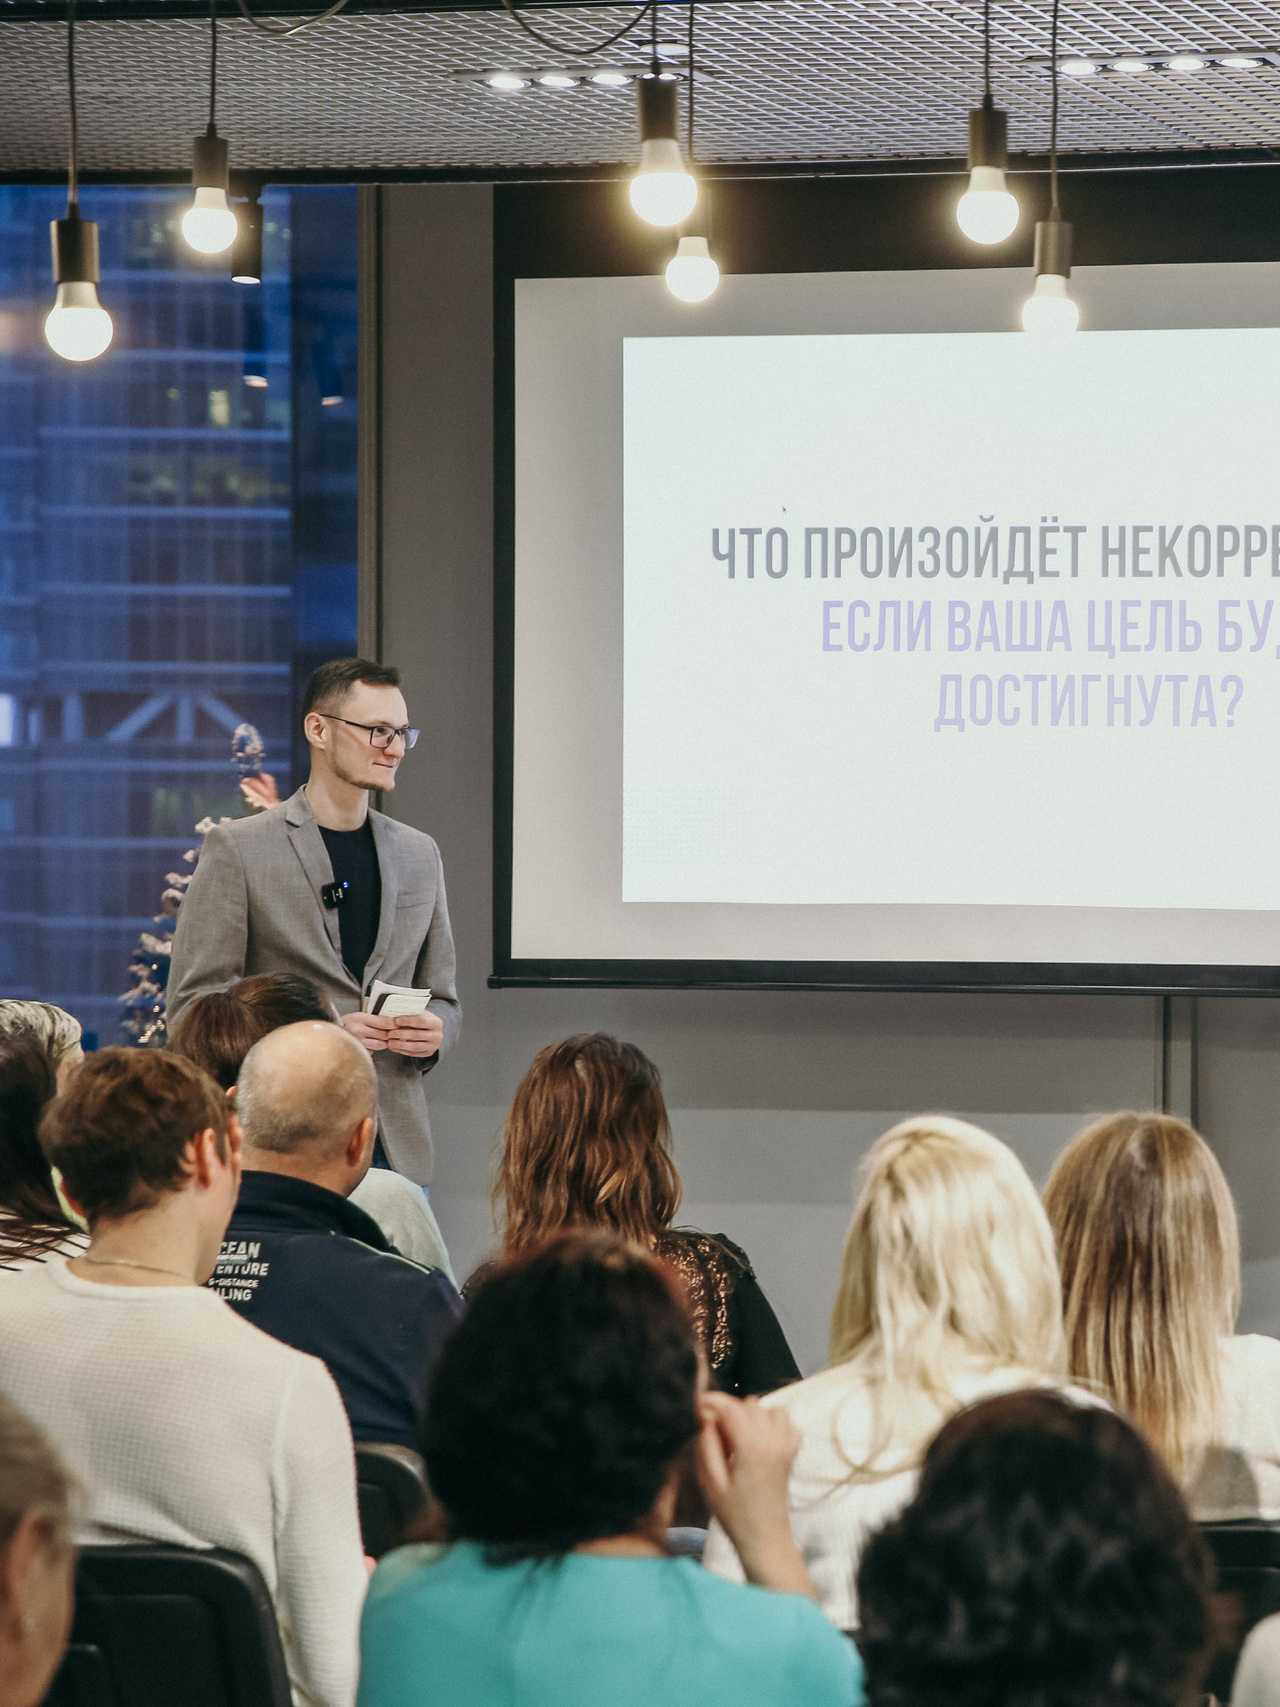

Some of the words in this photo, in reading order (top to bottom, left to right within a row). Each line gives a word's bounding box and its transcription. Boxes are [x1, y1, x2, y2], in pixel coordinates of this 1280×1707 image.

[710, 527, 789, 580] ЧТО
[802, 515, 1088, 584] ПРОИЗОЙДЁТ
[821, 600, 933, 653] ЕСЛИ
[947, 600, 1072, 652] ВАША
[1086, 600, 1203, 659] ЦЕЛЬ
[933, 673, 1245, 733] ДОСТИГНУТА?
[221, 1241, 261, 1259] CEAN
